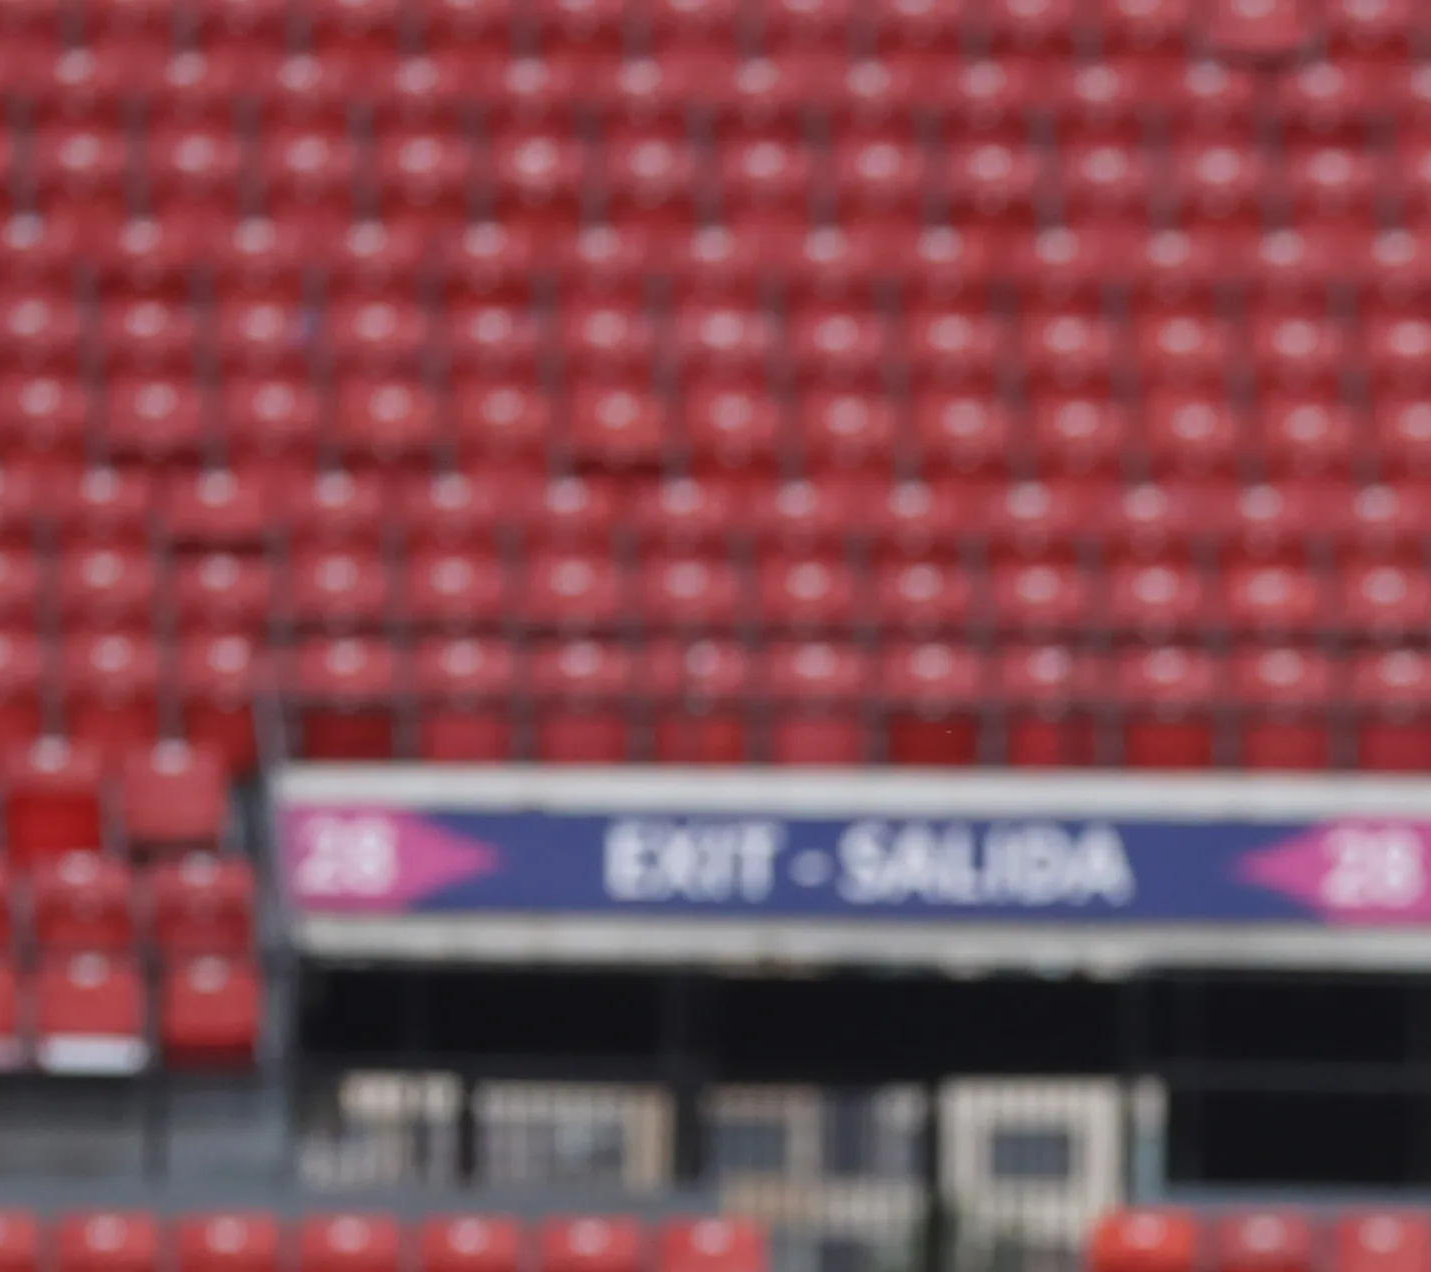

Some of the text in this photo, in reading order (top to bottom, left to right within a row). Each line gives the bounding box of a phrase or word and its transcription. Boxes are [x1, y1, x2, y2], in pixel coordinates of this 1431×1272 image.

[295, 813, 400, 899] 28
[603, 817, 783, 903] EXIT
[836, 817, 1137, 907] SALIDA
[1320, 824, 1424, 910] 28
